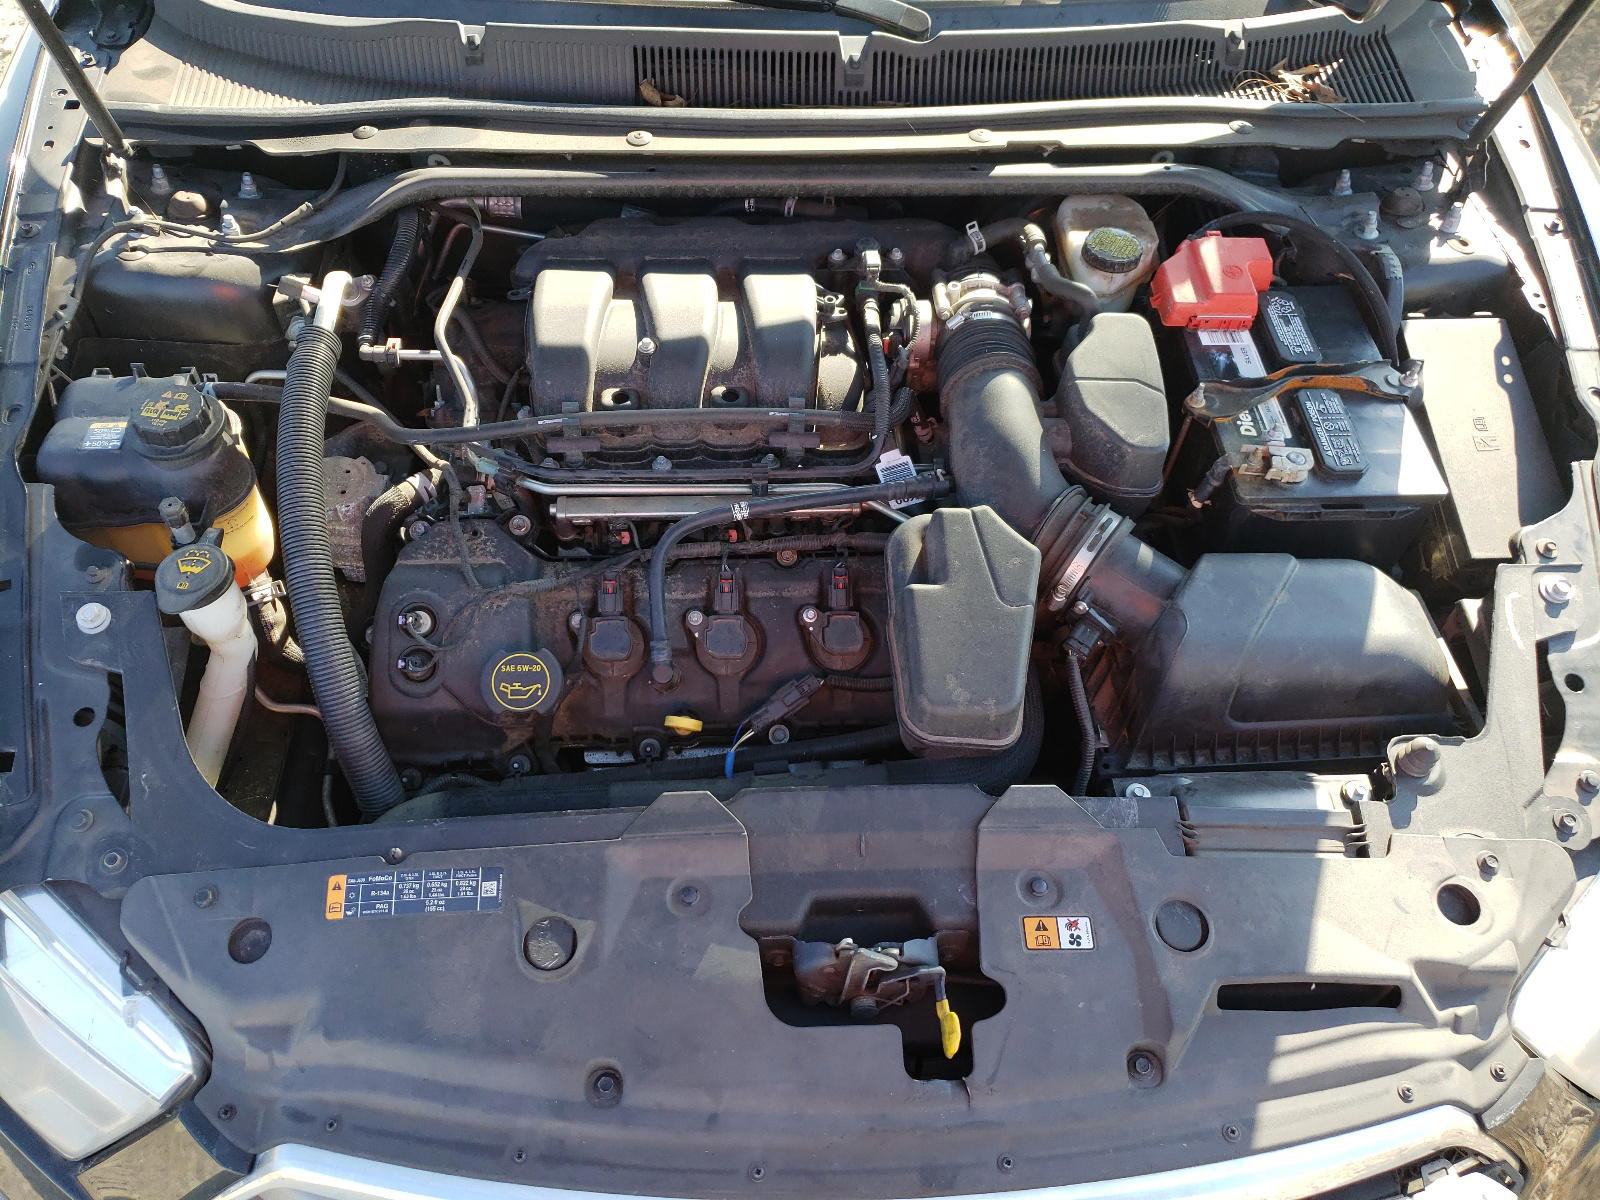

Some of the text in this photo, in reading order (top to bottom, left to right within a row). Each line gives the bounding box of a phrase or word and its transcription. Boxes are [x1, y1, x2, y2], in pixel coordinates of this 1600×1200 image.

[1304, 400, 1320, 422] POISON
[1315, 426, 1332, 451] DANGER
[517, 664, 541, 672] 5W-20
[368, 874, 393, 882] FoMoCo
